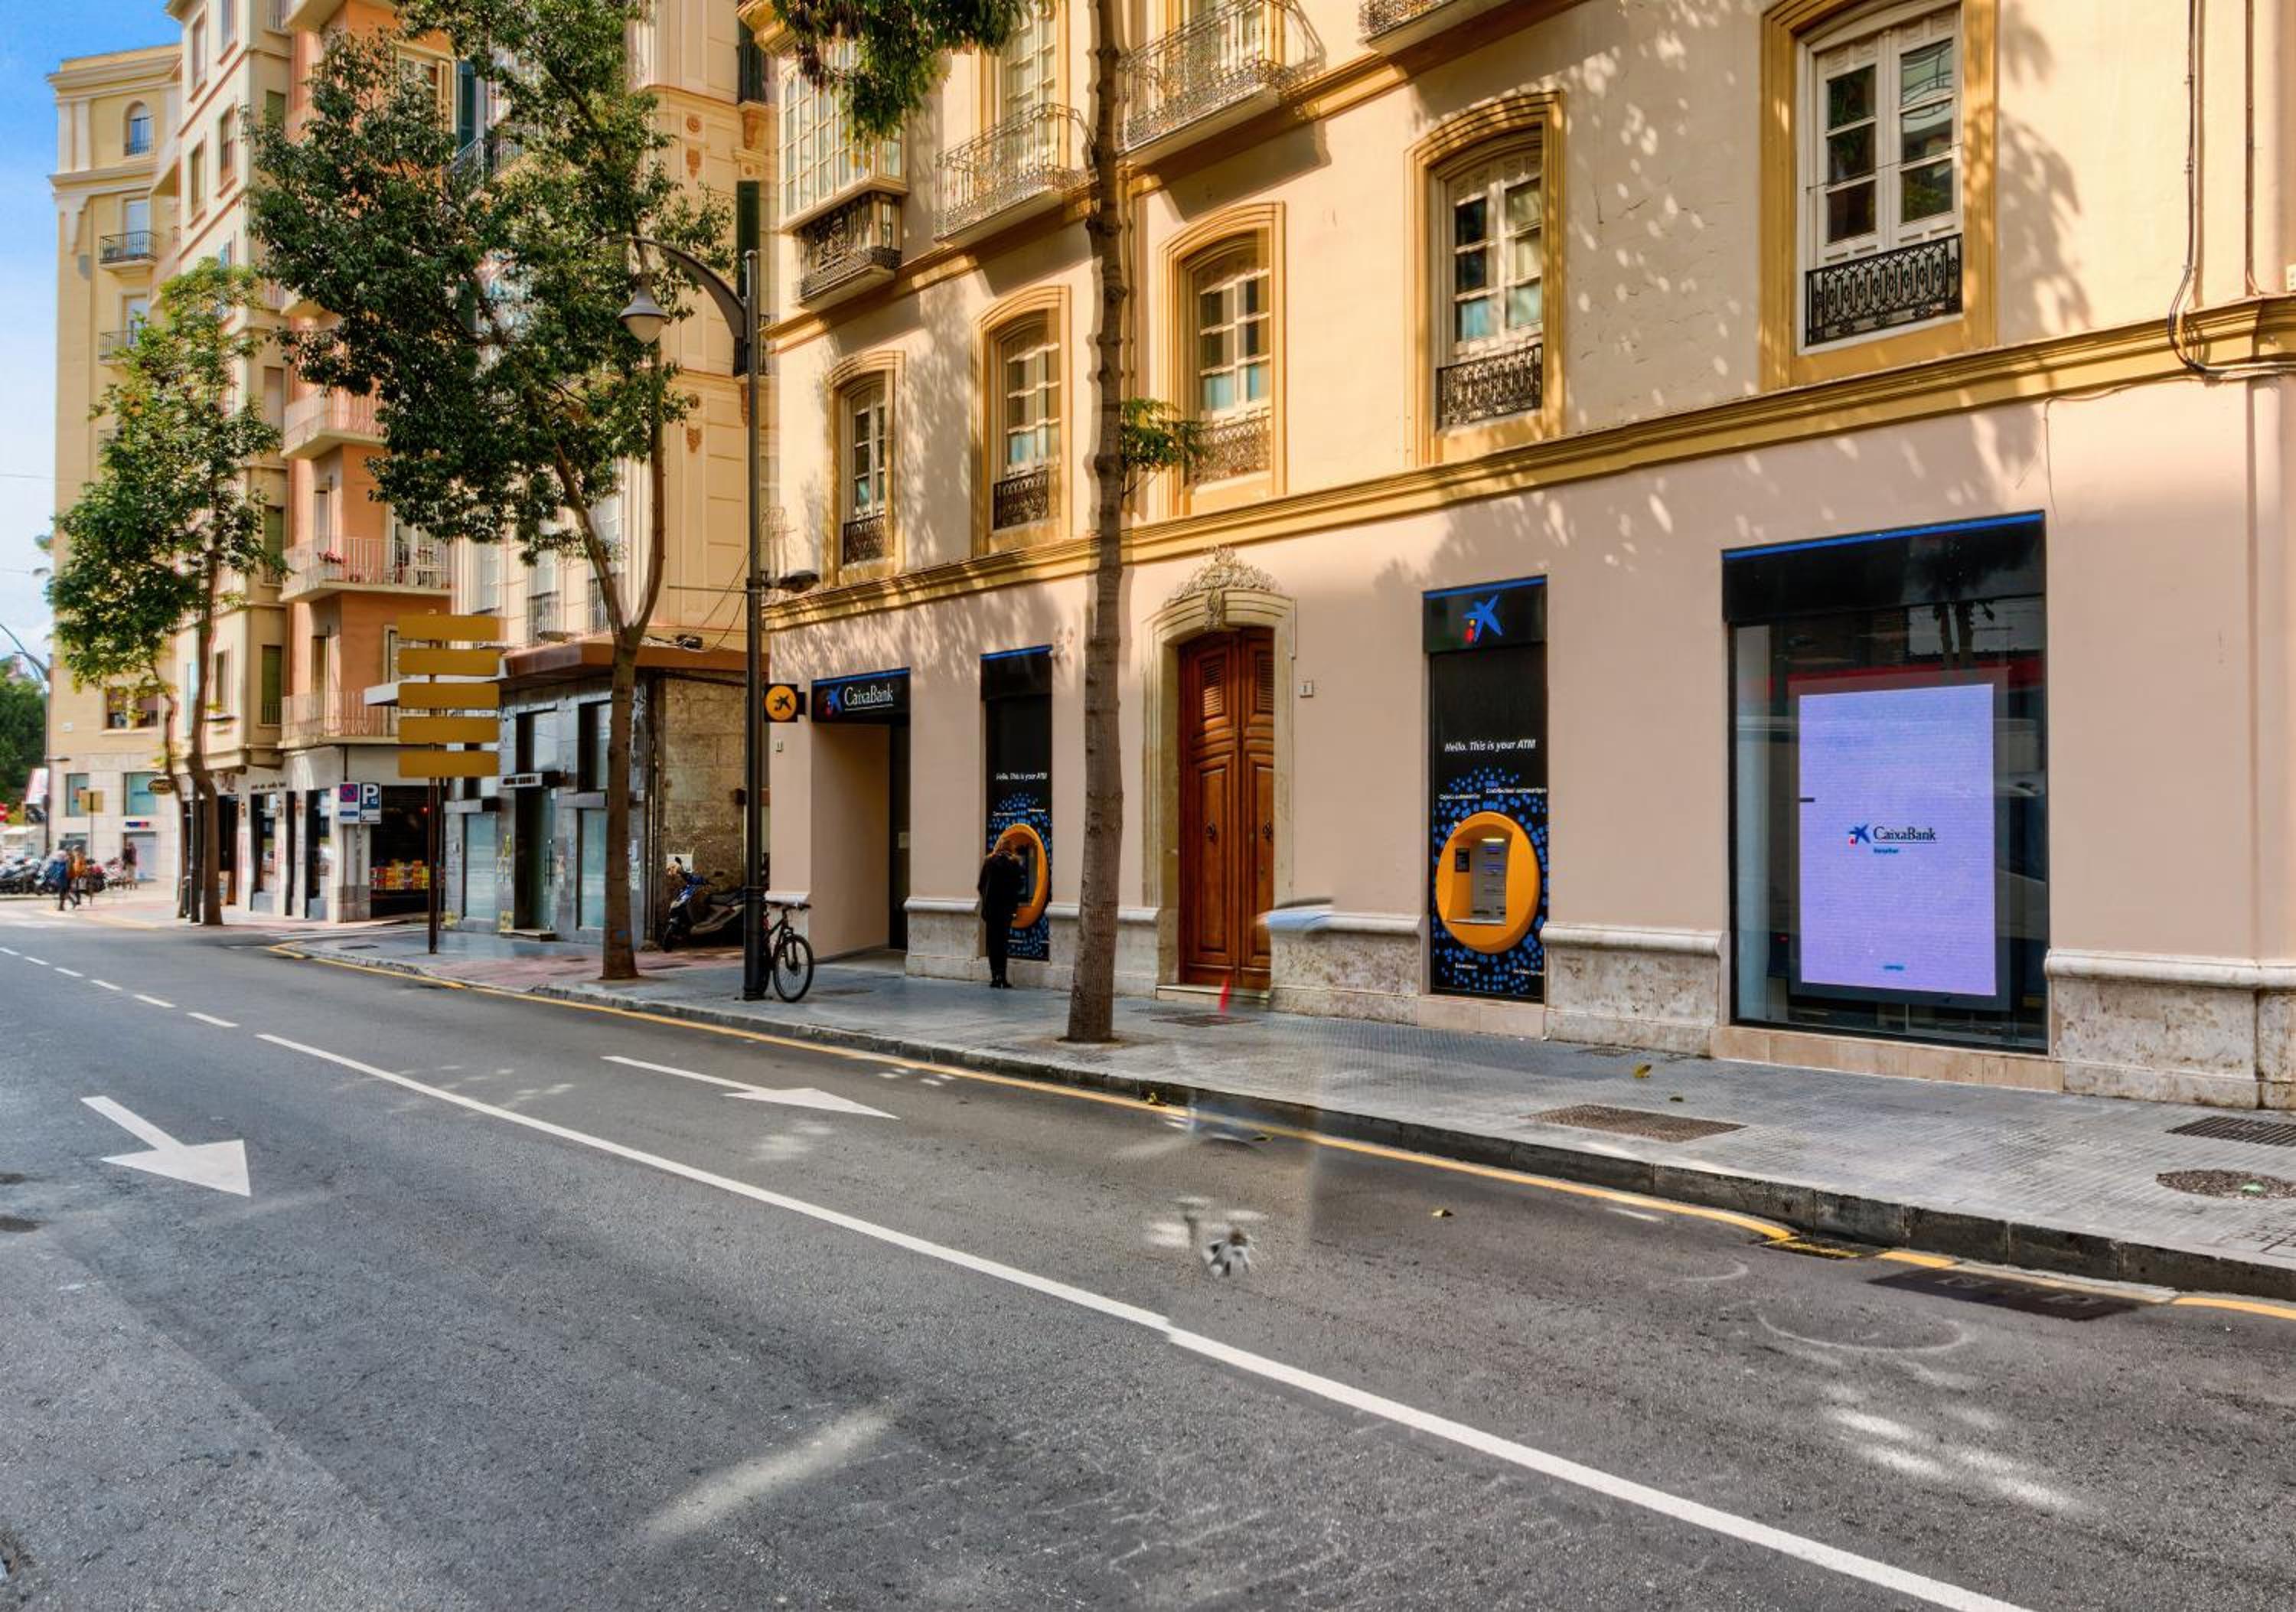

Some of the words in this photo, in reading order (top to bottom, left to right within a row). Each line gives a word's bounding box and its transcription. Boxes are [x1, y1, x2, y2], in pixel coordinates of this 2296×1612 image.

[844, 682, 894, 706] CaixaBank
[1470, 740, 1486, 751] This
[1488, 740, 1495, 750] is
[1495, 741, 1516, 752] your
[1517, 739, 1536, 749] ATM
[362, 784, 379, 804] P
[1873, 826, 1936, 841] CaixaBank
